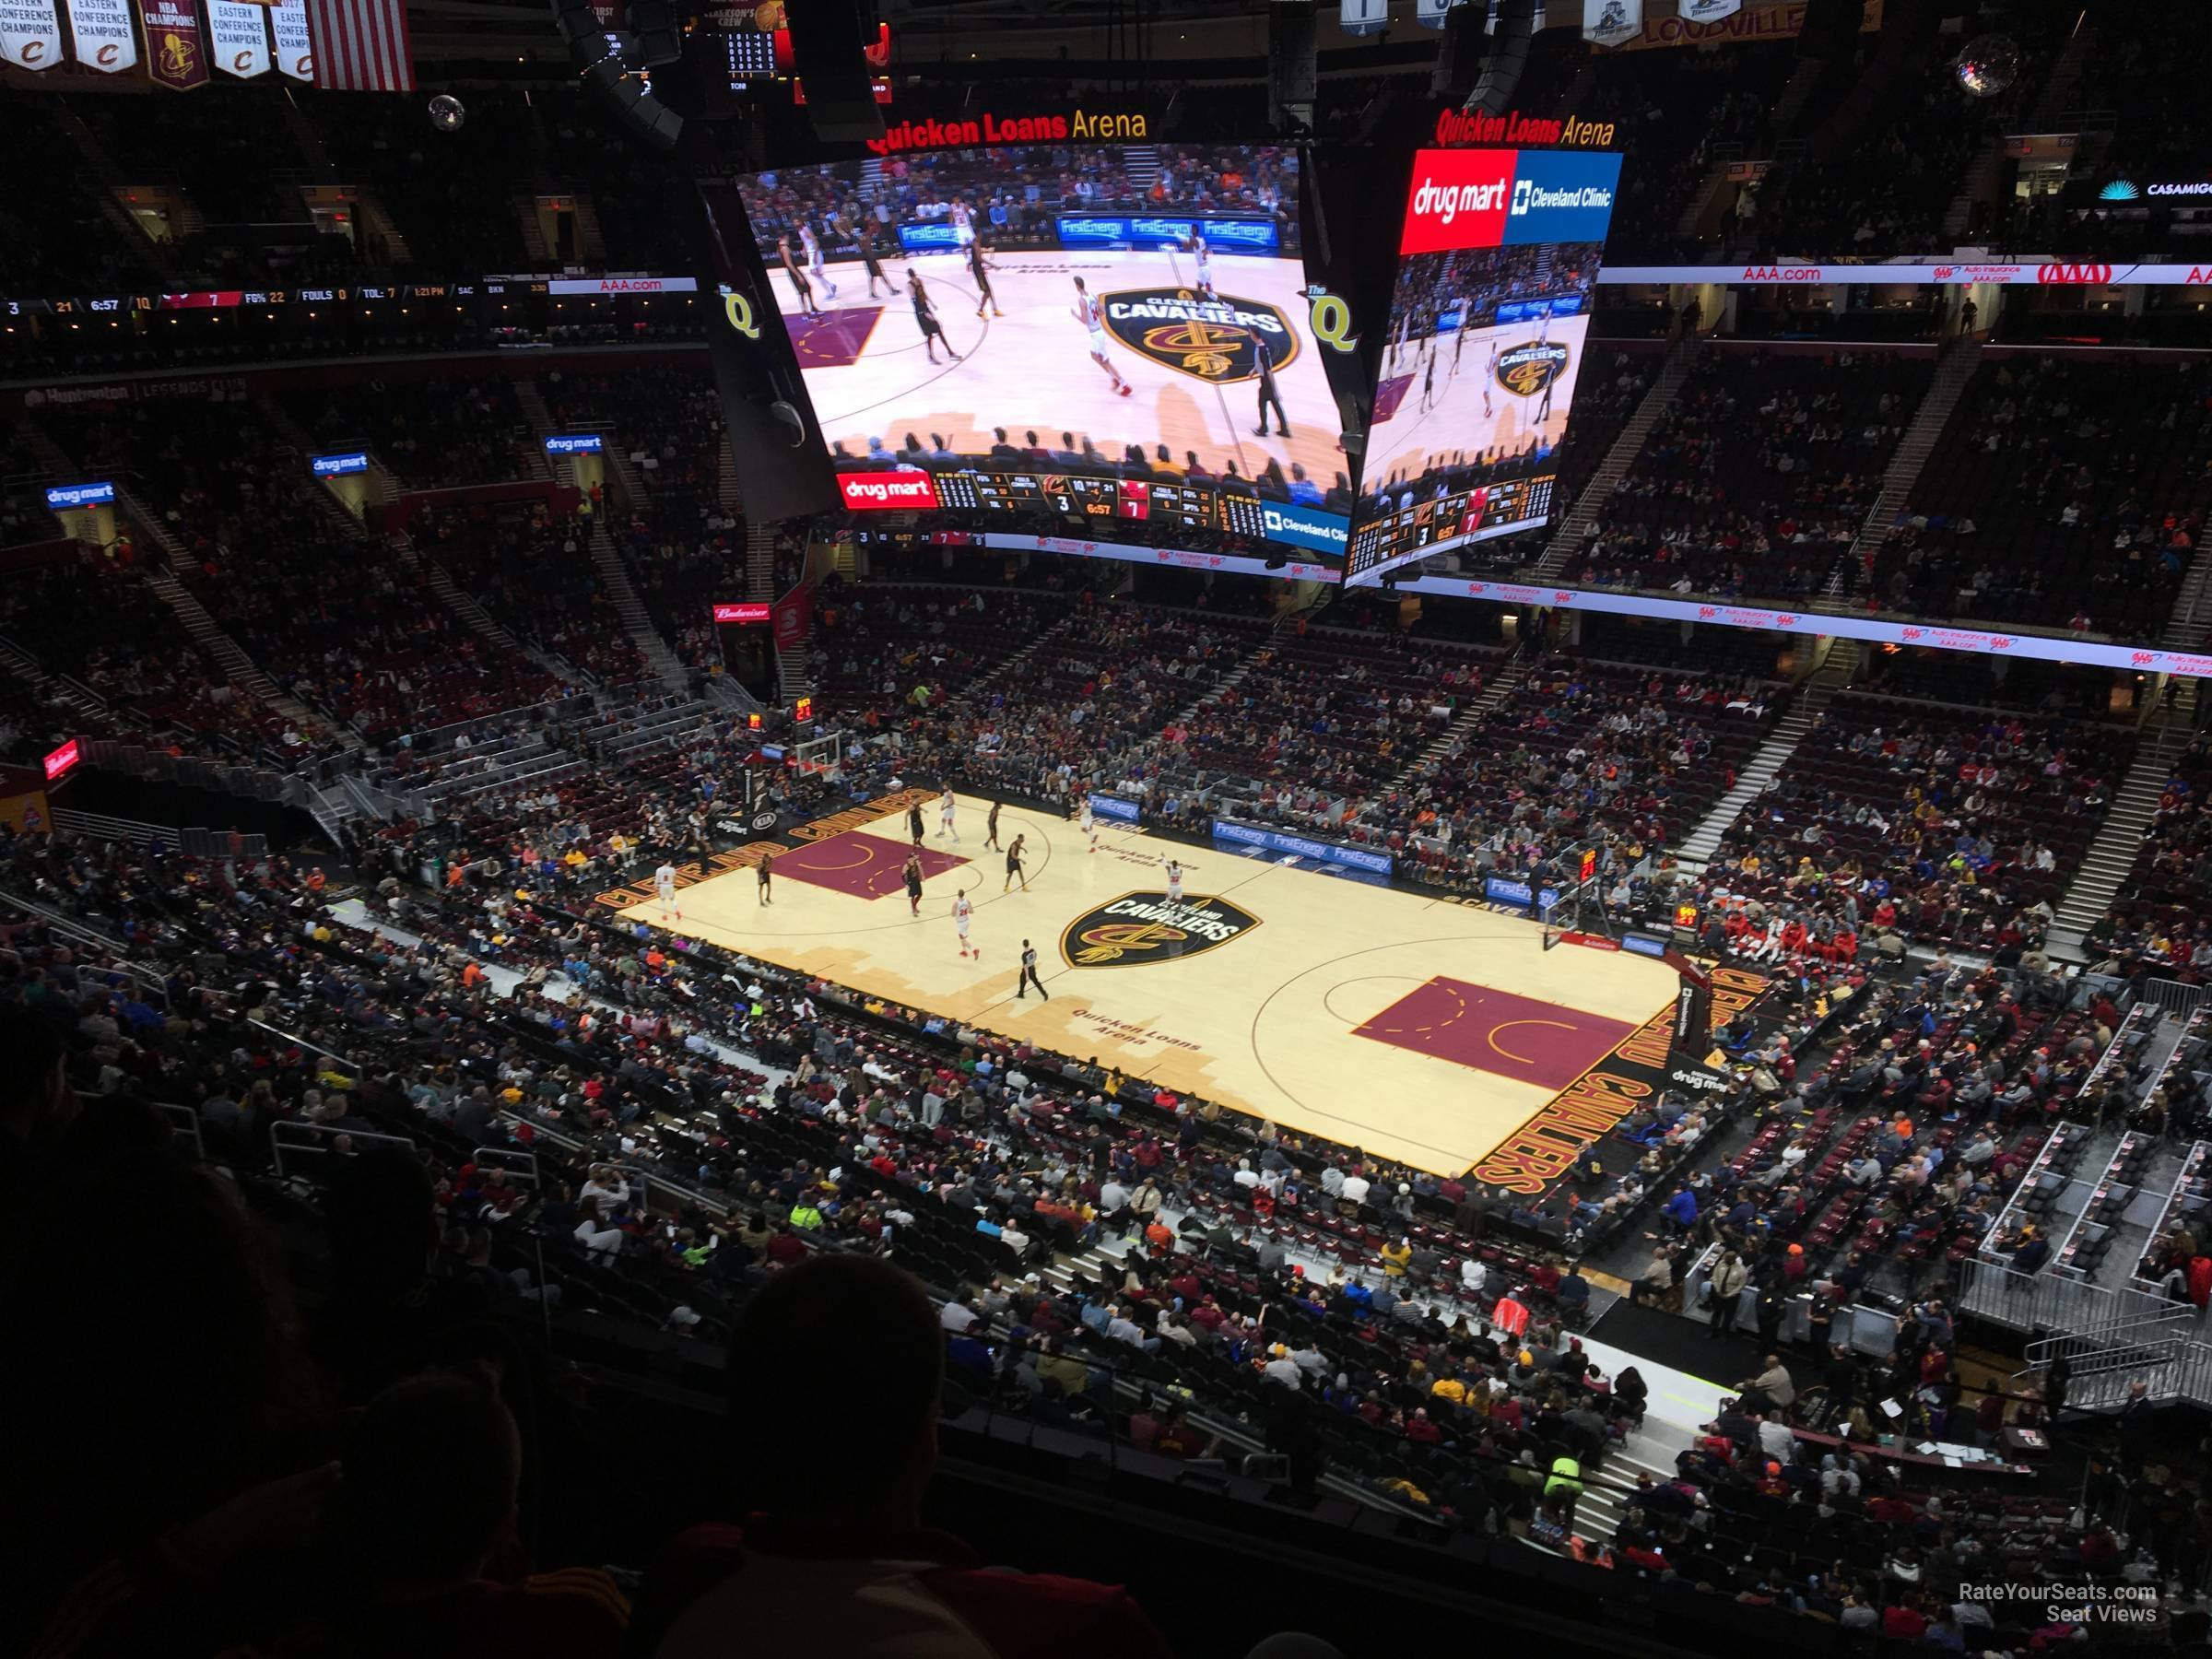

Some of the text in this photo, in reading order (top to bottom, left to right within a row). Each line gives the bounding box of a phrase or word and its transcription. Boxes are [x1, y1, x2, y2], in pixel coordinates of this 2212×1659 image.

[74, 11, 128, 24] CONFERENCE
[159, 2, 178, 15] NBA
[218, 6, 253, 18] EASTERN
[2, 23, 53, 35] CHAMPIONS
[146, 13, 195, 28] CHAMPIONS
[213, 19, 263, 32] CONFERENCE
[77, 26, 128, 38] CHAMPIONS
[218, 33, 262, 45] CHAMPIONS
[983, 113, 1067, 143] Loans
[1073, 110, 1147, 138] Arena
[1436, 108, 1614, 147] Quicken Loans Arena
[1414, 178, 1506, 224] drug mart
[1531, 188, 1612, 207] Cleveland Clinic
[1742, 266, 1821, 281] AAA.com
[2041, 265, 2110, 284] AAA
[601, 279, 663, 292] AAA.com
[1308, 285, 1327, 296] The
[8, 302, 19, 314] 3
[56, 302, 73, 312] 21
[91, 300, 119, 311] 6:57
[209, 294, 218, 306] 7
[245, 293, 266, 303] FG%
[269, 292, 285, 302] 22
[302, 289, 333, 300] FOULS
[388, 288, 396, 298] 7
[725, 292, 760, 338] Q
[1110, 302, 1284, 333] CAVALIERS
[1309, 295, 1359, 352] Q
[1500, 349, 1567, 367] CAVALIERS
[547, 437, 601, 450] drug mart
[313, 455, 367, 472] drug mart
[47, 484, 113, 503] drug mart
[846, 481, 888, 500] drug
[888, 480, 930, 496] mart
[1058, 497, 1069, 512] 3
[1087, 503, 1111, 514] 6:57
[1127, 501, 1137, 516] 7
[1283, 518, 1331, 540] Cleveland
[1467, 513, 1476, 532] 7
[859, 532, 868, 543] 3
[939, 533, 947, 544] 7
[1419, 527, 1430, 546] 3
[757, 816, 772, 827] KIA
[788, 787, 941, 841] CAVALIERS
[1275, 834, 1327, 858] FirstEnergy
[1335, 847, 1392, 869] FirstEnergy
[1104, 900, 1240, 942] CAVALIERS
[1072, 1009, 1203, 1051] Quicken Loans
[1092, 1026, 1147, 1045] Arena
[1672, 1070, 1704, 1089] drug
[1474, 1072, 1653, 1194] CAVALIERS
